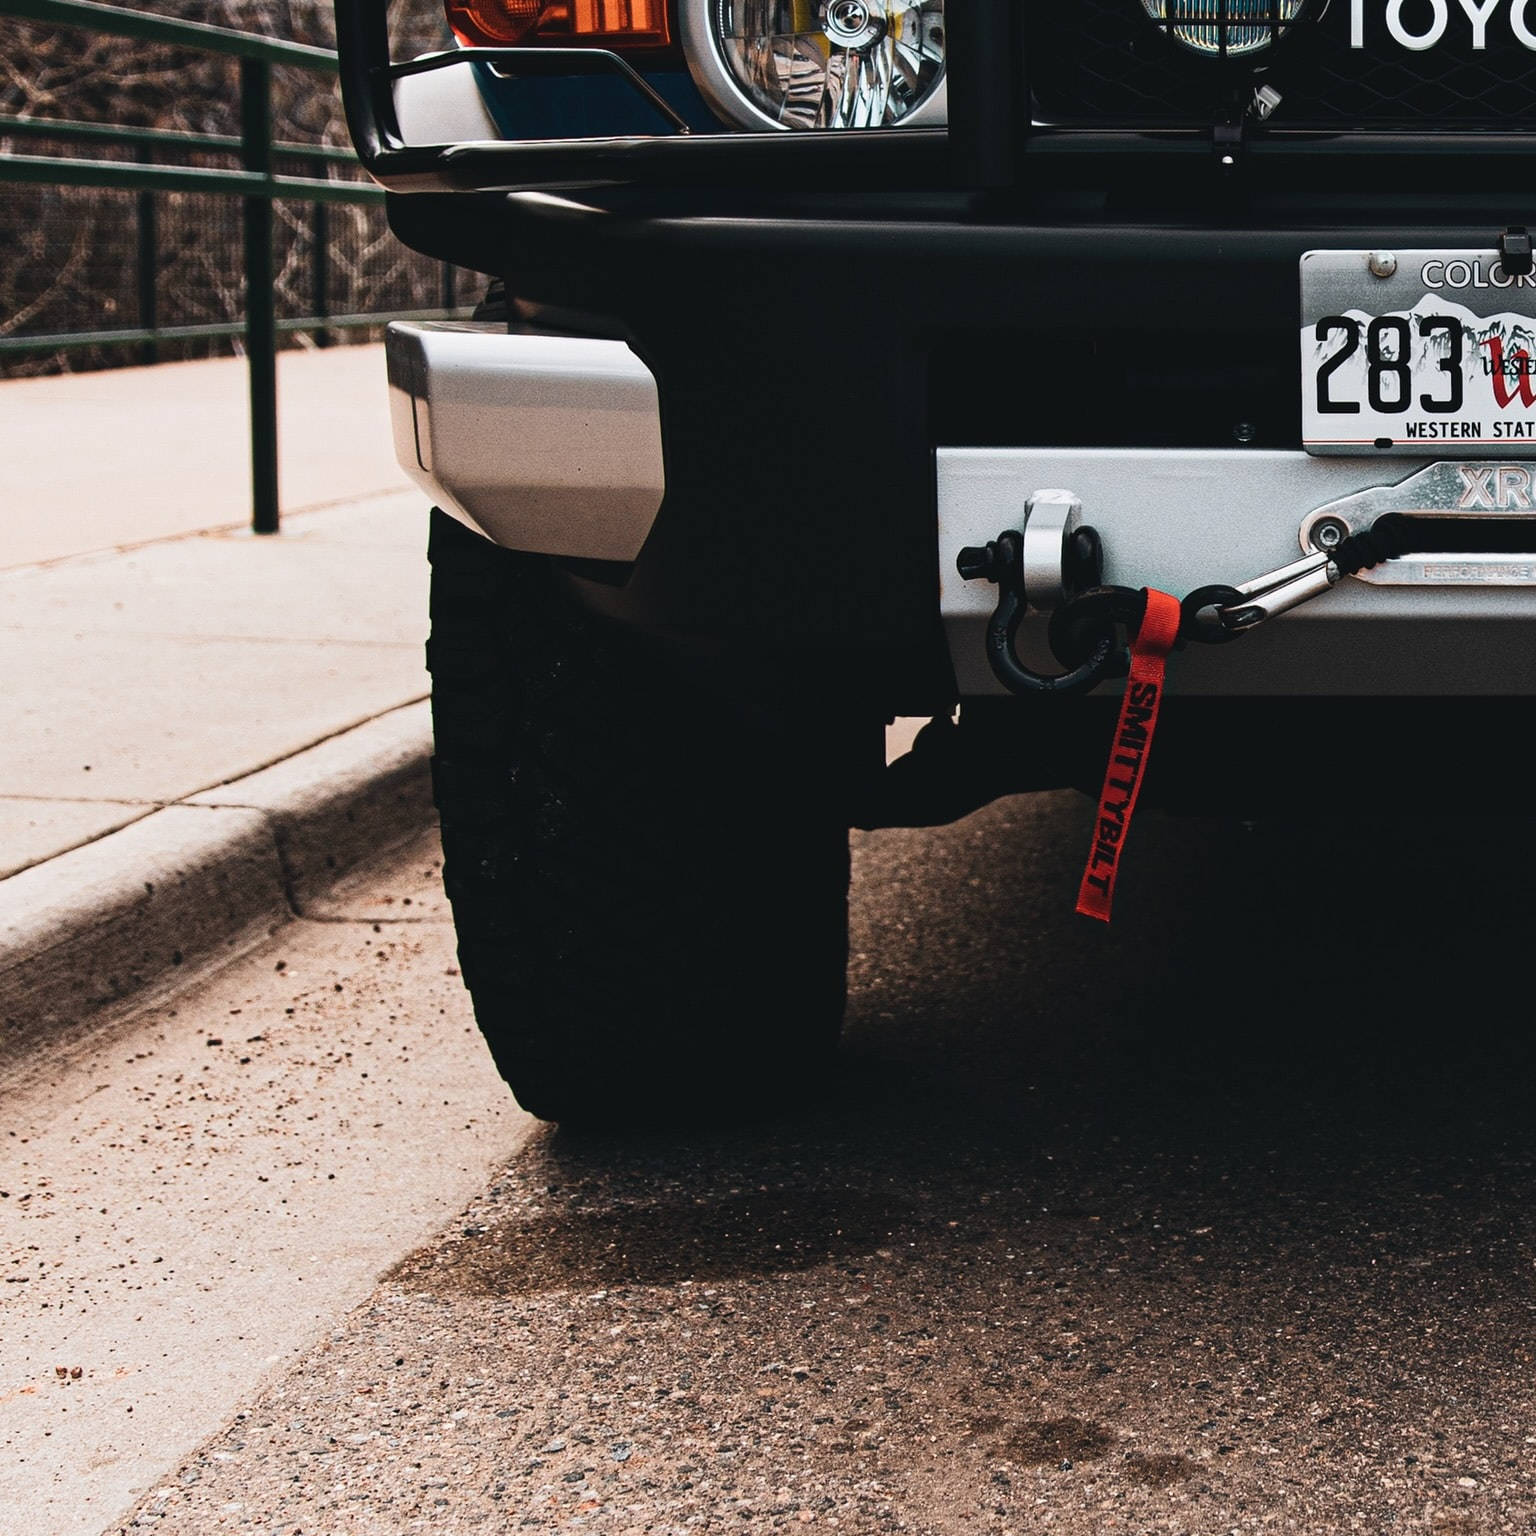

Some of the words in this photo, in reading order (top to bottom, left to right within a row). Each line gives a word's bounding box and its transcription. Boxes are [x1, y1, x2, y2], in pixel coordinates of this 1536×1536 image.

[1315, 315, 1463, 414] 283
[1405, 421, 1482, 438] WESTERN
[1087, 681, 1158, 899] SMITTYBILT
